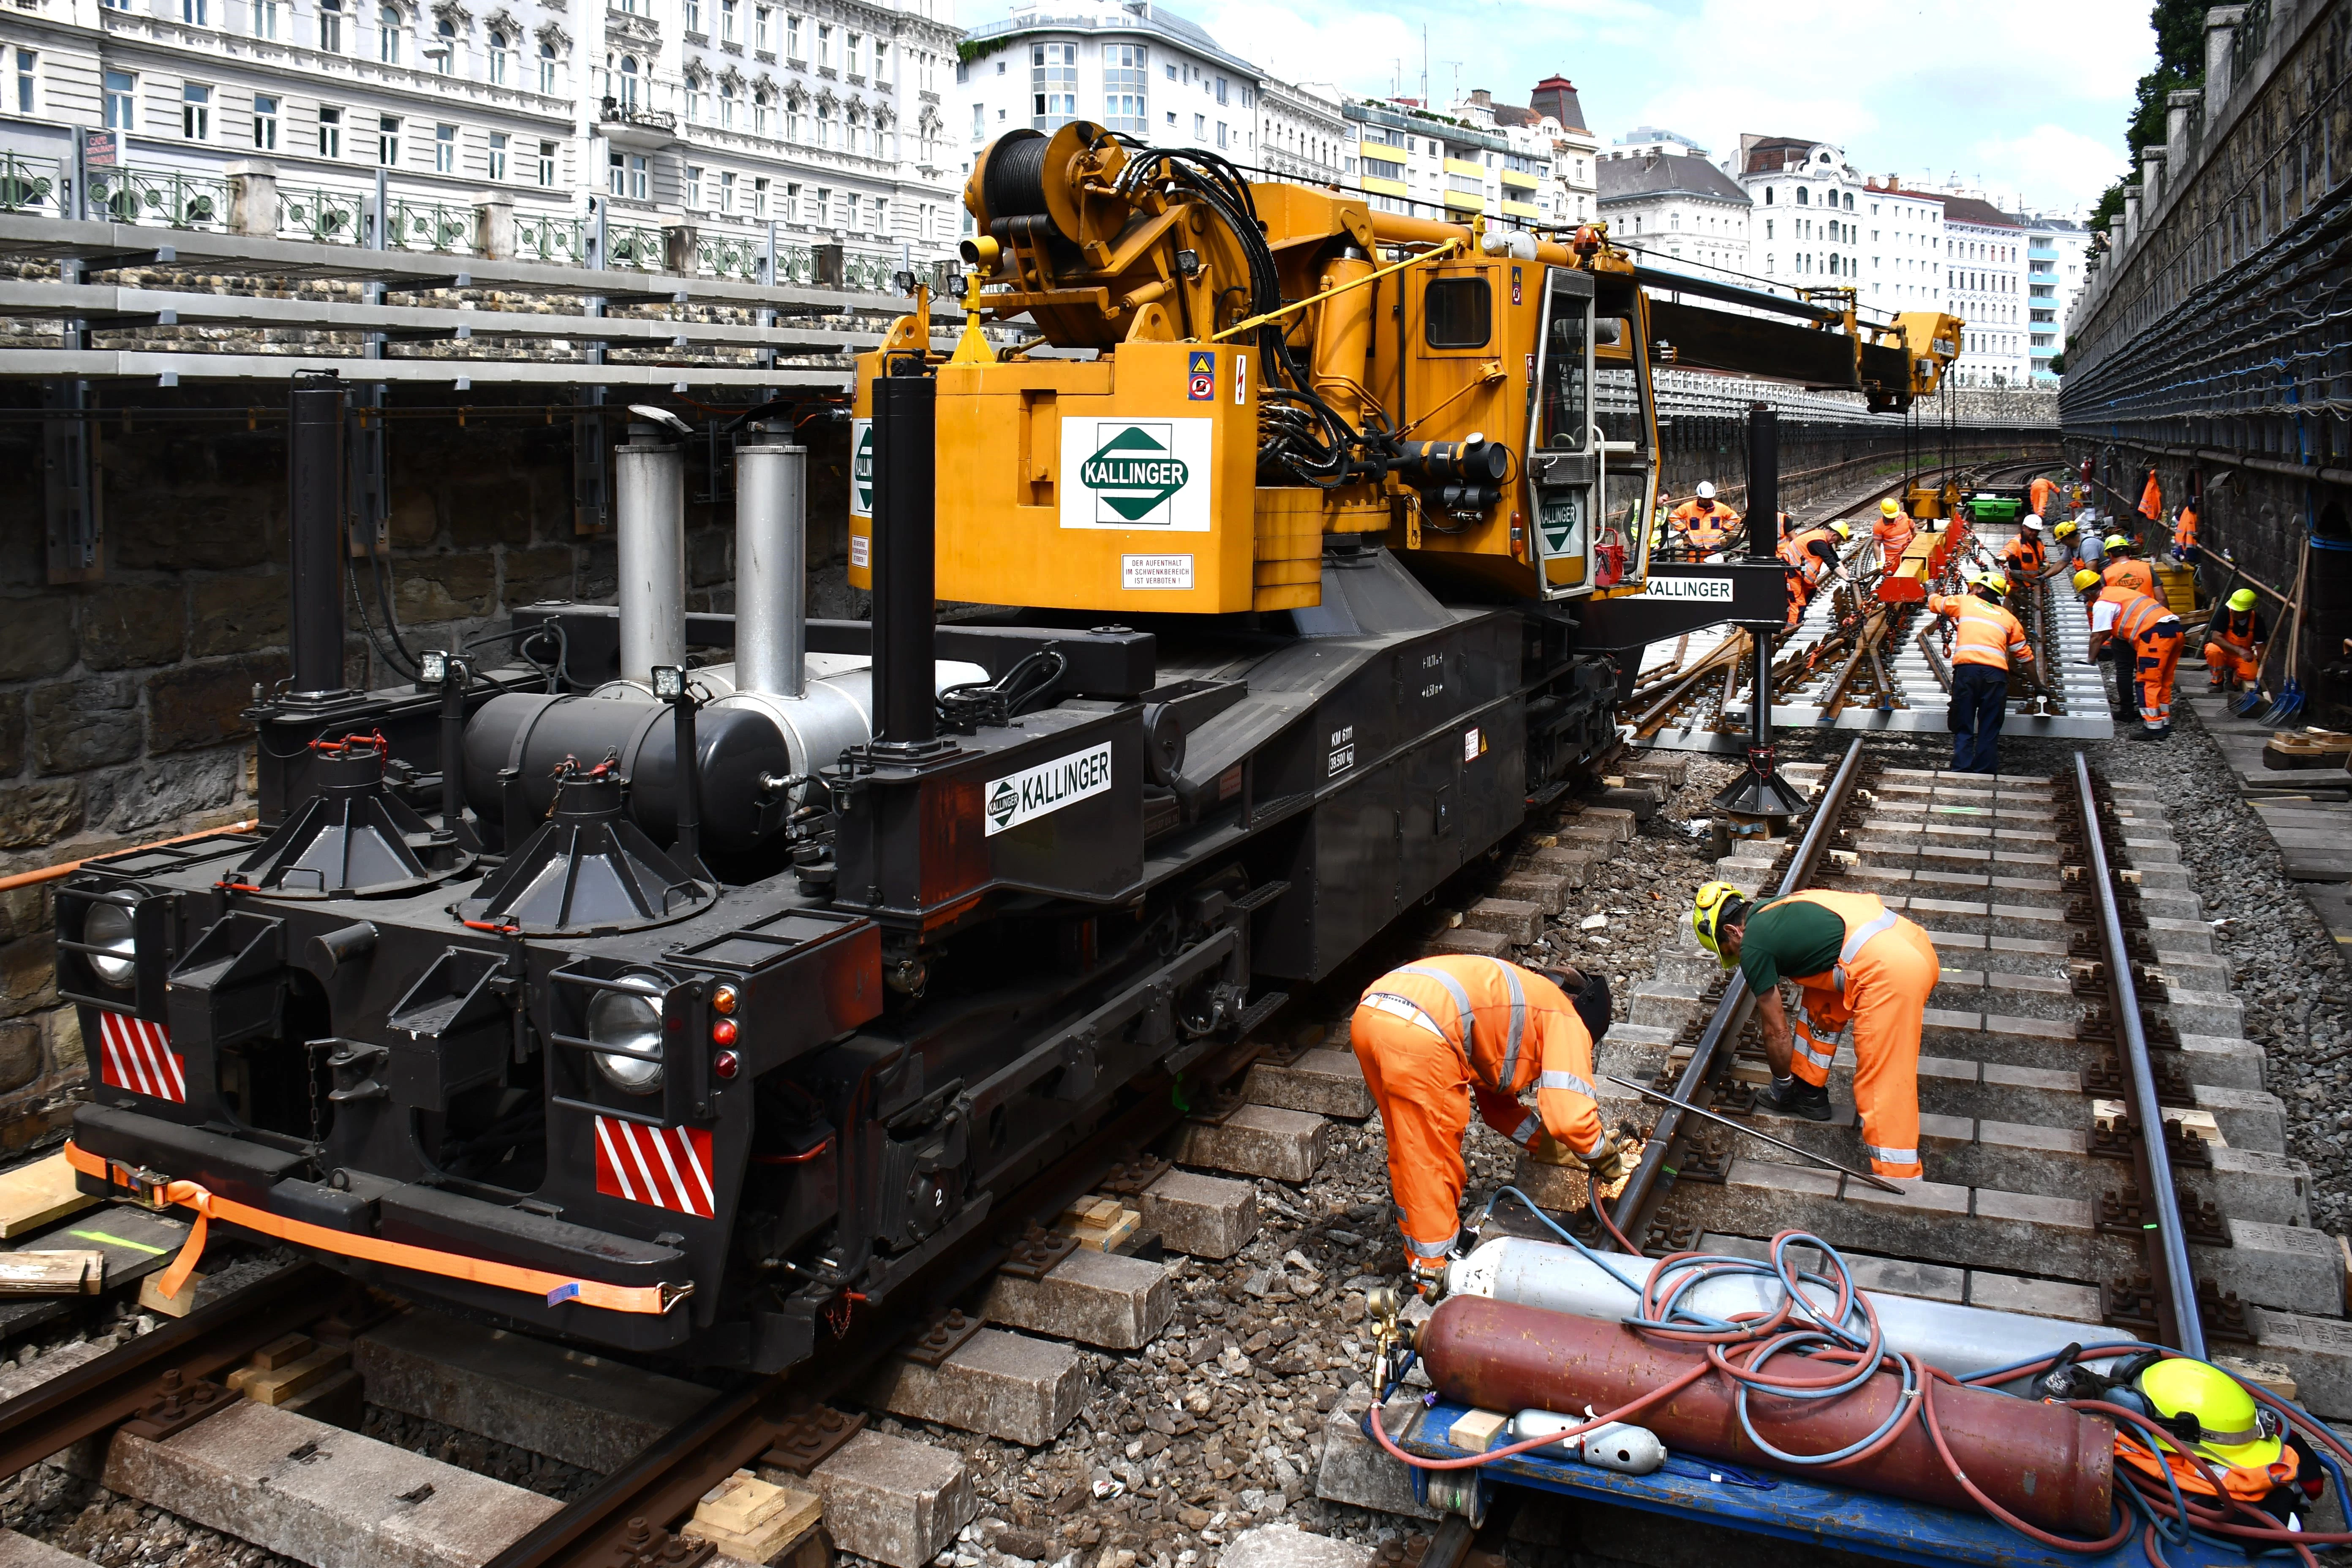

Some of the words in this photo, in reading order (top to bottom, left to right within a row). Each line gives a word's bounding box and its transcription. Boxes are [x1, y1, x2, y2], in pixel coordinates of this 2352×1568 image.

[1085, 462, 1184, 485] KALLINGER
[1540, 506, 1575, 524] KALLINGER
[1645, 581, 1730, 597] KALLINGER
[1331, 730, 1341, 747] KM
[1342, 725, 1352, 742] 6111
[1330, 752, 1345, 770] 39.500
[1347, 750, 1352, 764] kg
[1023, 751, 1108, 813] KALLINGER
[988, 794, 1018, 814] KALLINGER
[935, 1189, 942, 1207] 2
[2311, 1323, 2331, 1344] MABA
